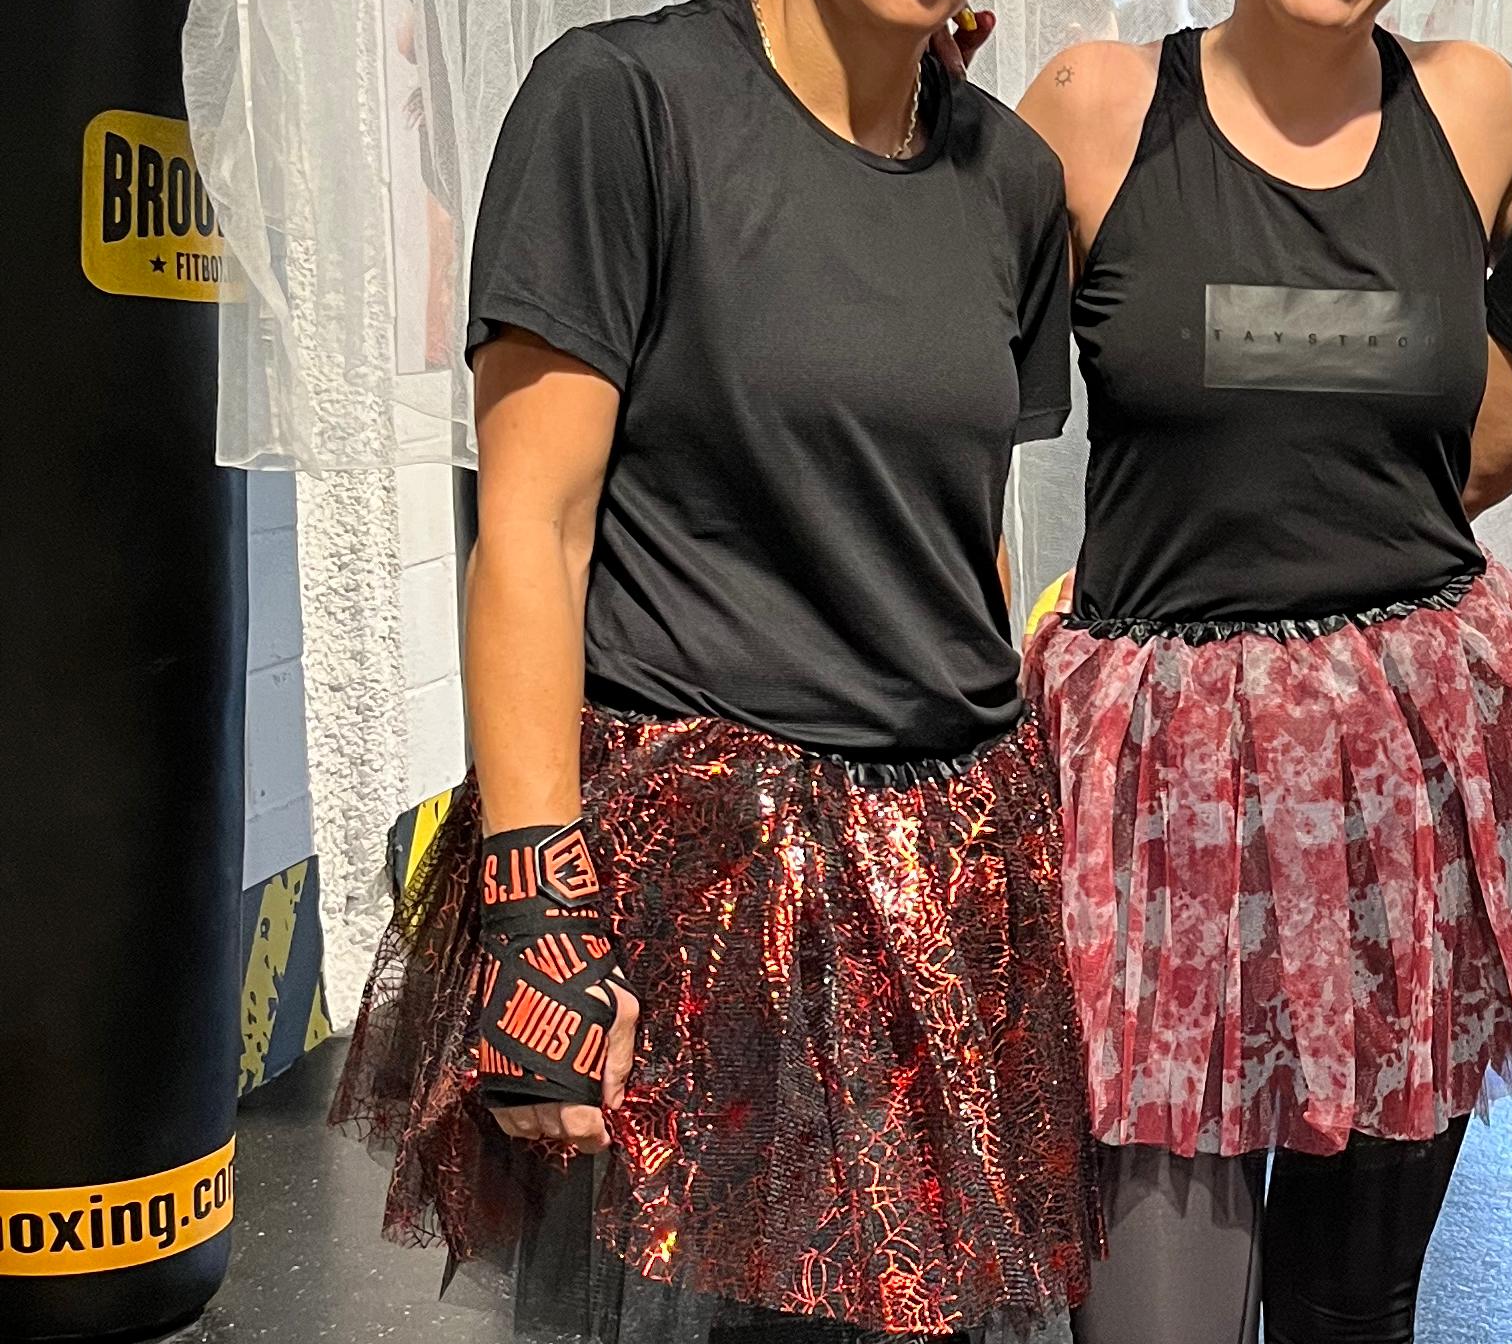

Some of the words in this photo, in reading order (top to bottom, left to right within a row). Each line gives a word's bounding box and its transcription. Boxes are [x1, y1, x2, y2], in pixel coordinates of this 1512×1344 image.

[102, 132, 225, 243] BROO
[484, 846, 537, 905] IT'S
[518, 933, 588, 984] TIM
[496, 979, 583, 1062] SHINE
[0, 1161, 236, 1254] oxing.co
